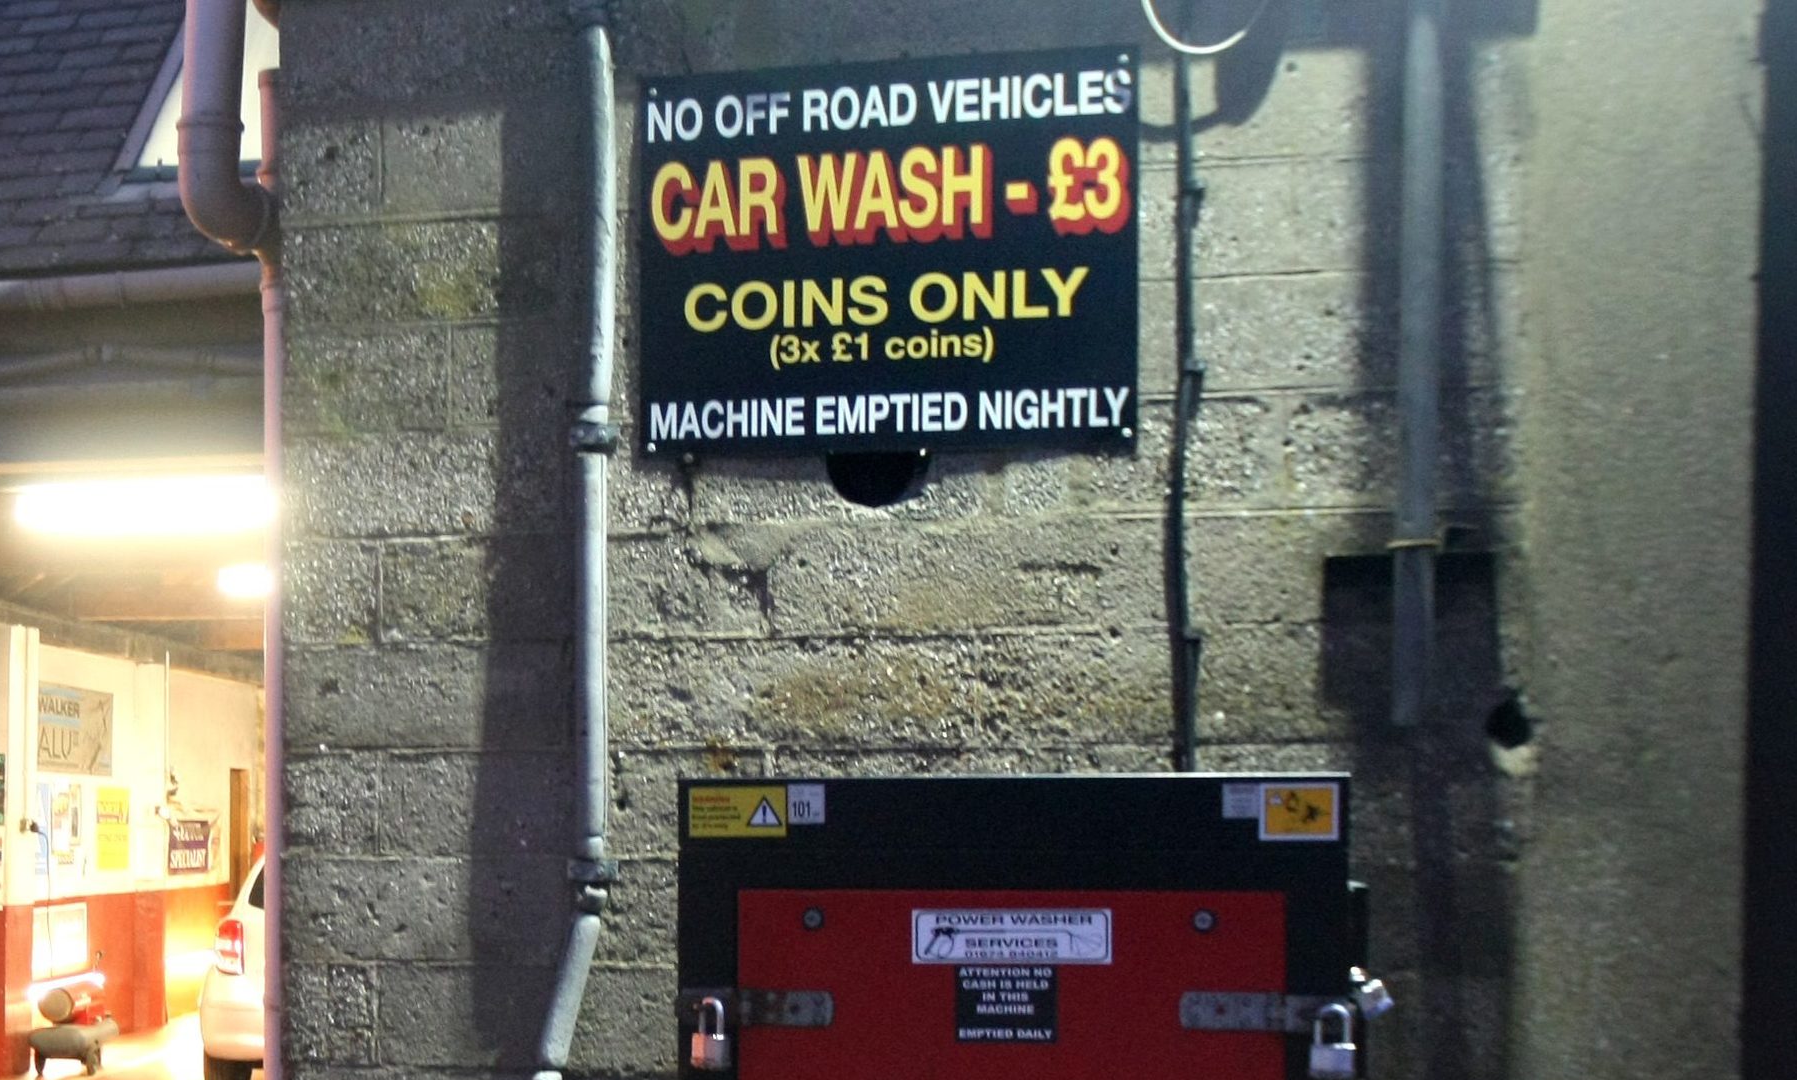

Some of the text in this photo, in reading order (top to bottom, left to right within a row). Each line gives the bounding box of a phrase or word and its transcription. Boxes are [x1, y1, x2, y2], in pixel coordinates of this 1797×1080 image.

[647, 69, 1132, 143] NO OFF ROAD VEHICLES
[651, 136, 1130, 256] CAR WASH - £3
[684, 265, 1090, 333] COINS ONLY
[769, 325, 995, 370] (3x £1 coins)
[649, 386, 1131, 442] MACHINE EMPTIED NIGHTLY
[37, 695, 81, 719] WALKER
[791, 800, 812, 818] 101
[170, 848, 207, 869] SPECIALIST
[935, 914, 1093, 925] POWER WASHER
[964, 938, 1058, 948] SERVICES
[958, 967, 1053, 978] ATTENTION NO
[962, 979, 1049, 990] CASH IS HELD
[982, 991, 1029, 1002] IN THIS
[976, 1003, 1035, 1015] MACHINE
[958, 1028, 1053, 1040] EMPTIED DAILY
